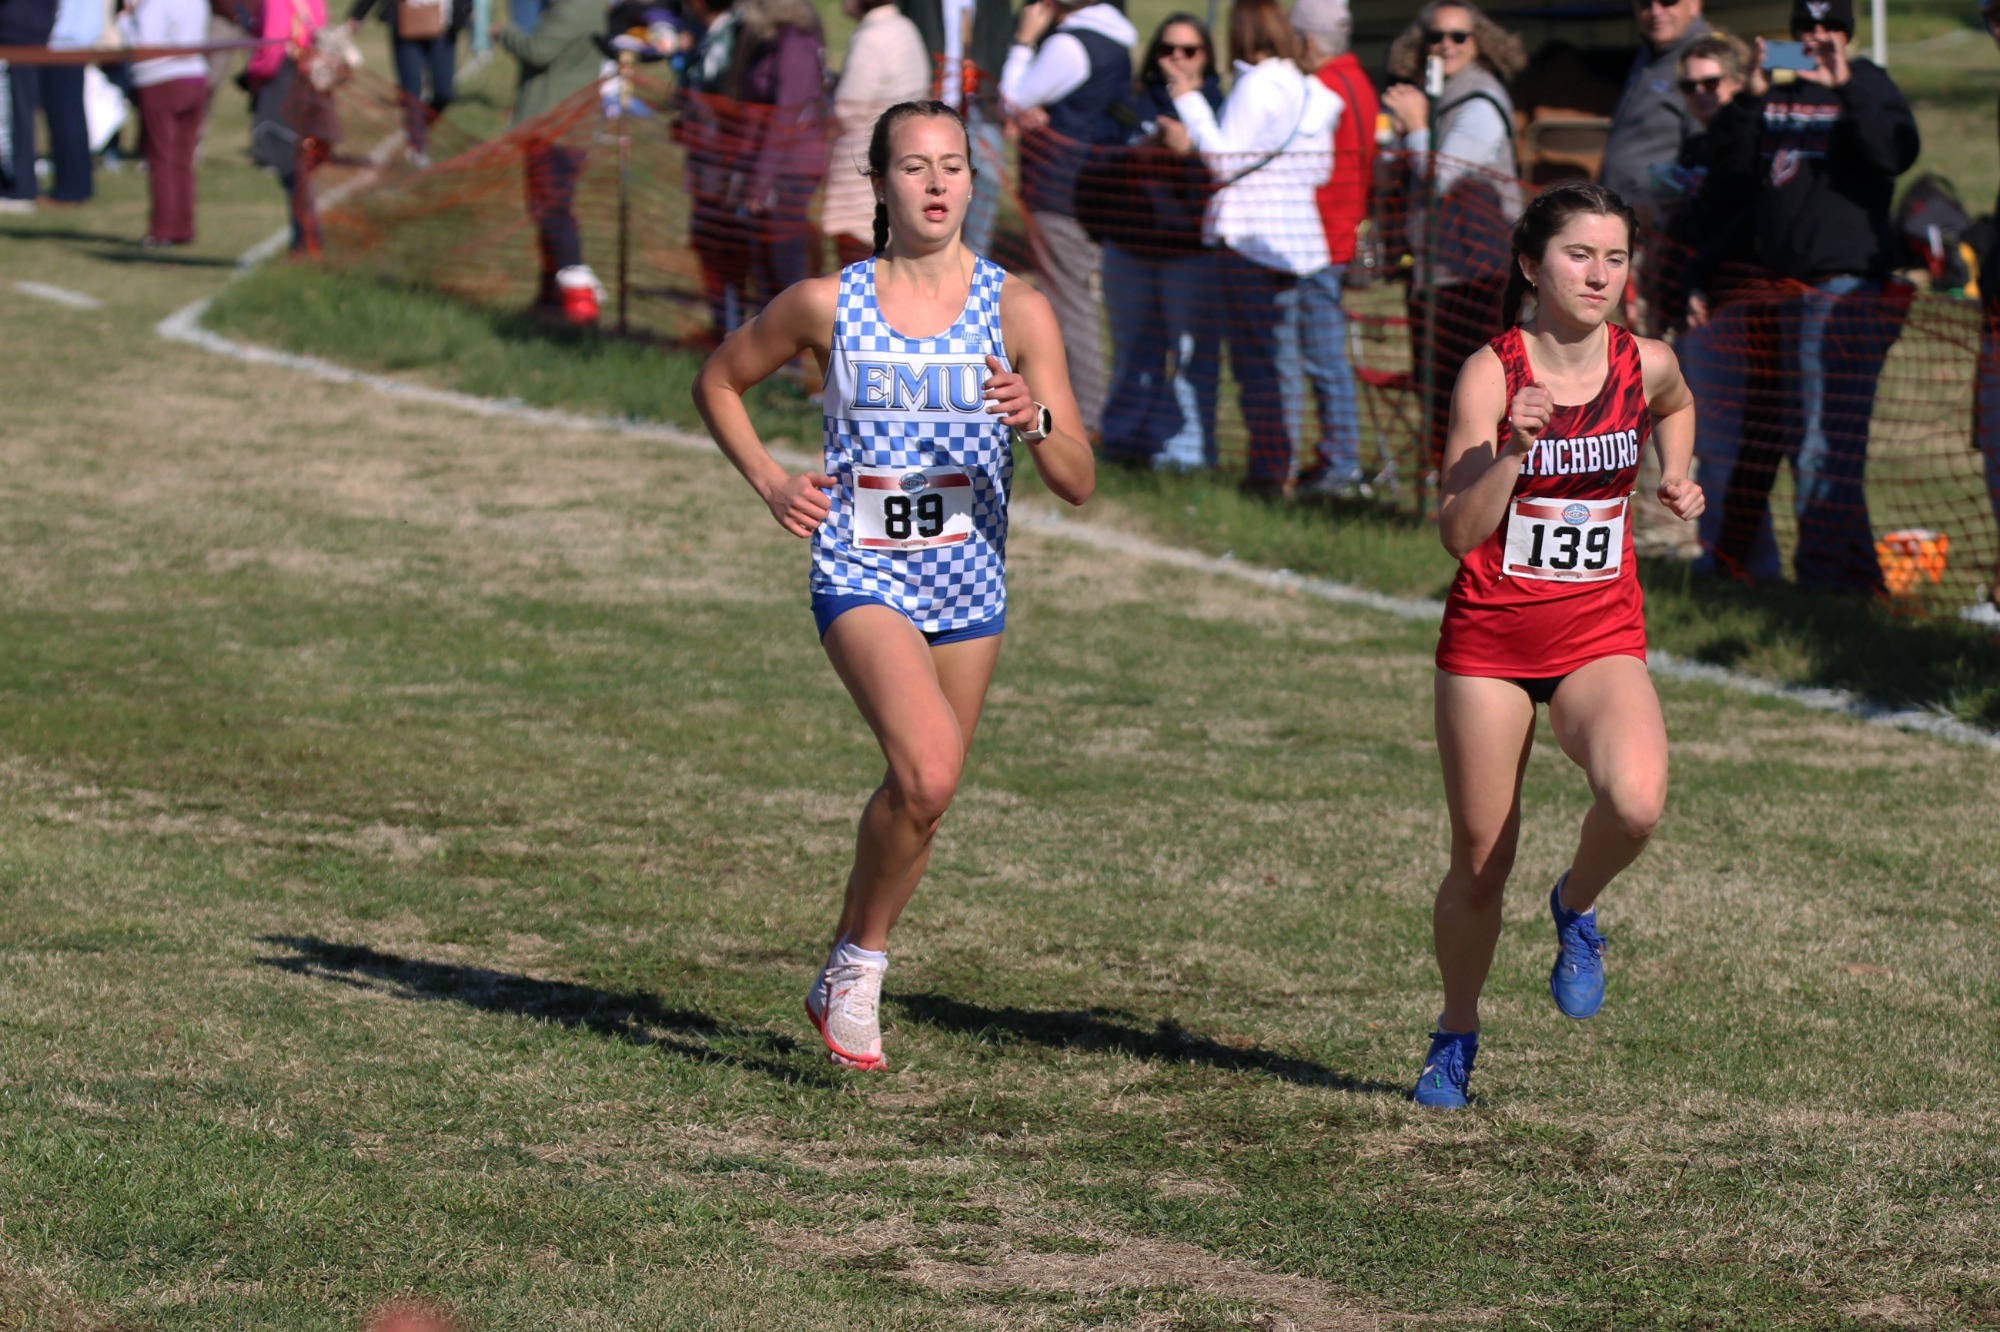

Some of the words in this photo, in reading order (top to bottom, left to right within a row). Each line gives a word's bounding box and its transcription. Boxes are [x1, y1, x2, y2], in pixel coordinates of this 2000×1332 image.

[849, 360, 989, 414] EMU
[1519, 429, 1638, 475] YNCHBURG
[884, 493, 943, 539] 89
[1528, 524, 1610, 570] 139
